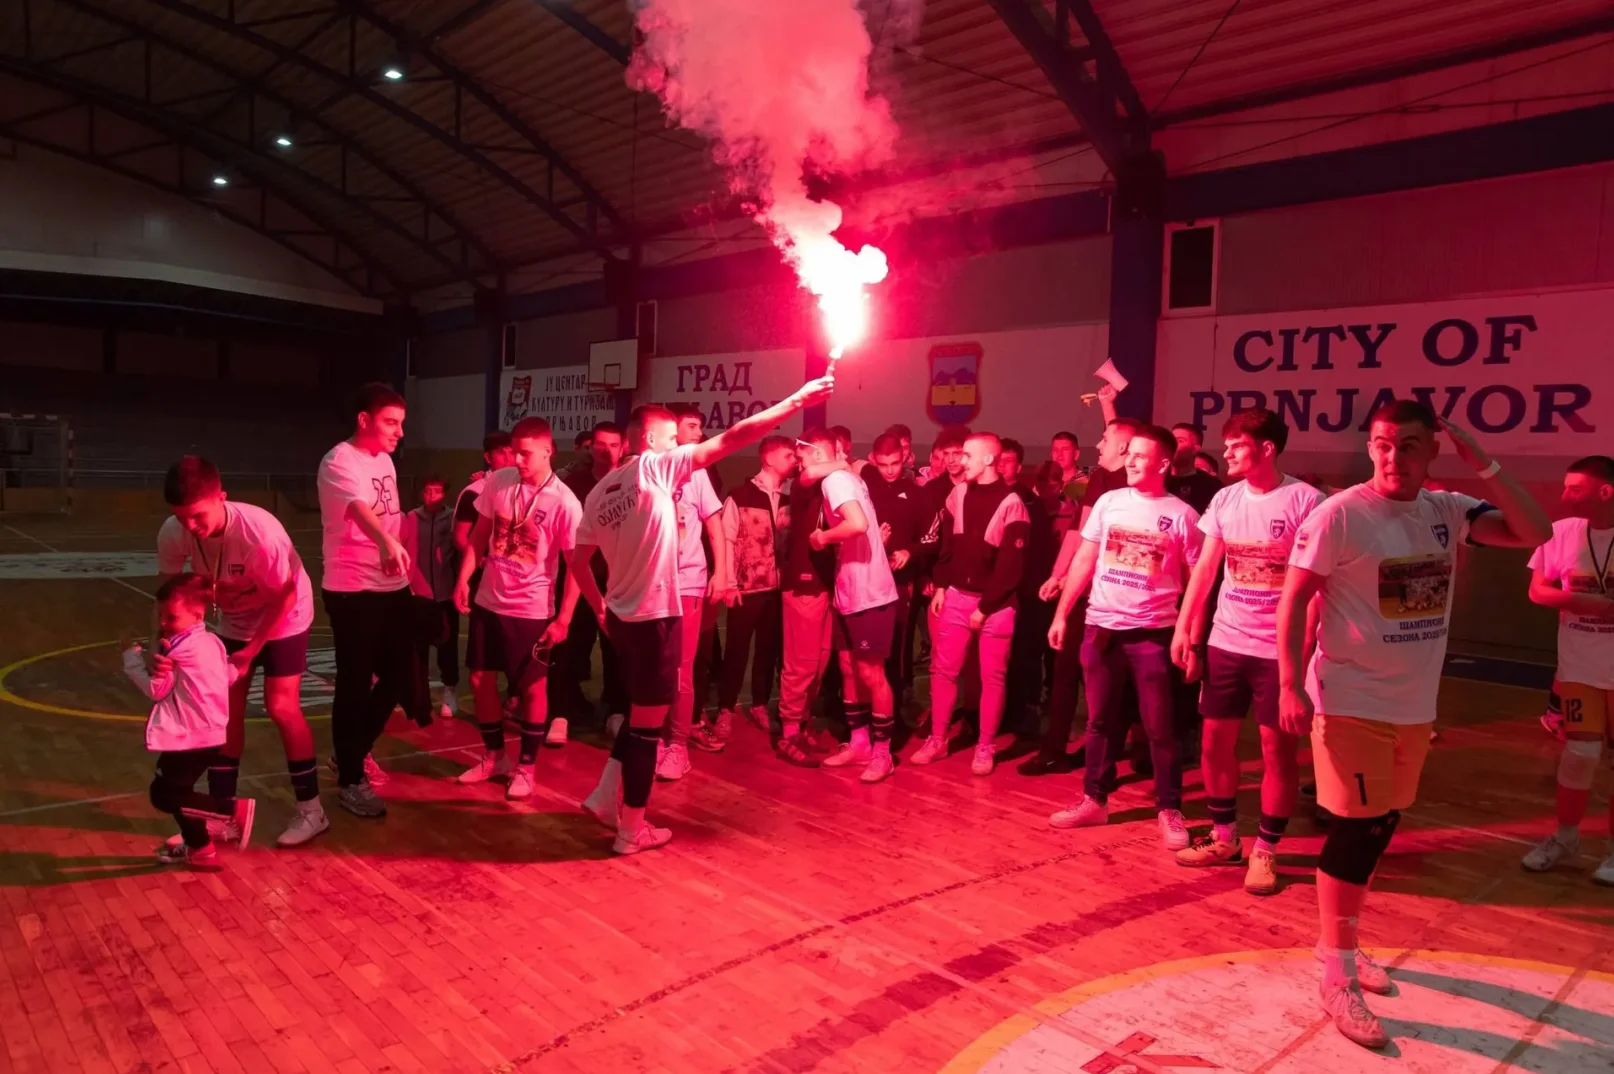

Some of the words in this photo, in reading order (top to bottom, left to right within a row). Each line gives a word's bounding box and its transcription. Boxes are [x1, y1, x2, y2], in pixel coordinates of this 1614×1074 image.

[1232, 322, 1397, 373] CITY
[1421, 314, 1538, 367] OF
[676, 362, 752, 396] ГРАД
[1383, 632, 1420, 643] СЕЗОНА
[1565, 698, 1582, 722] 12
[1354, 772, 1367, 806] 1
